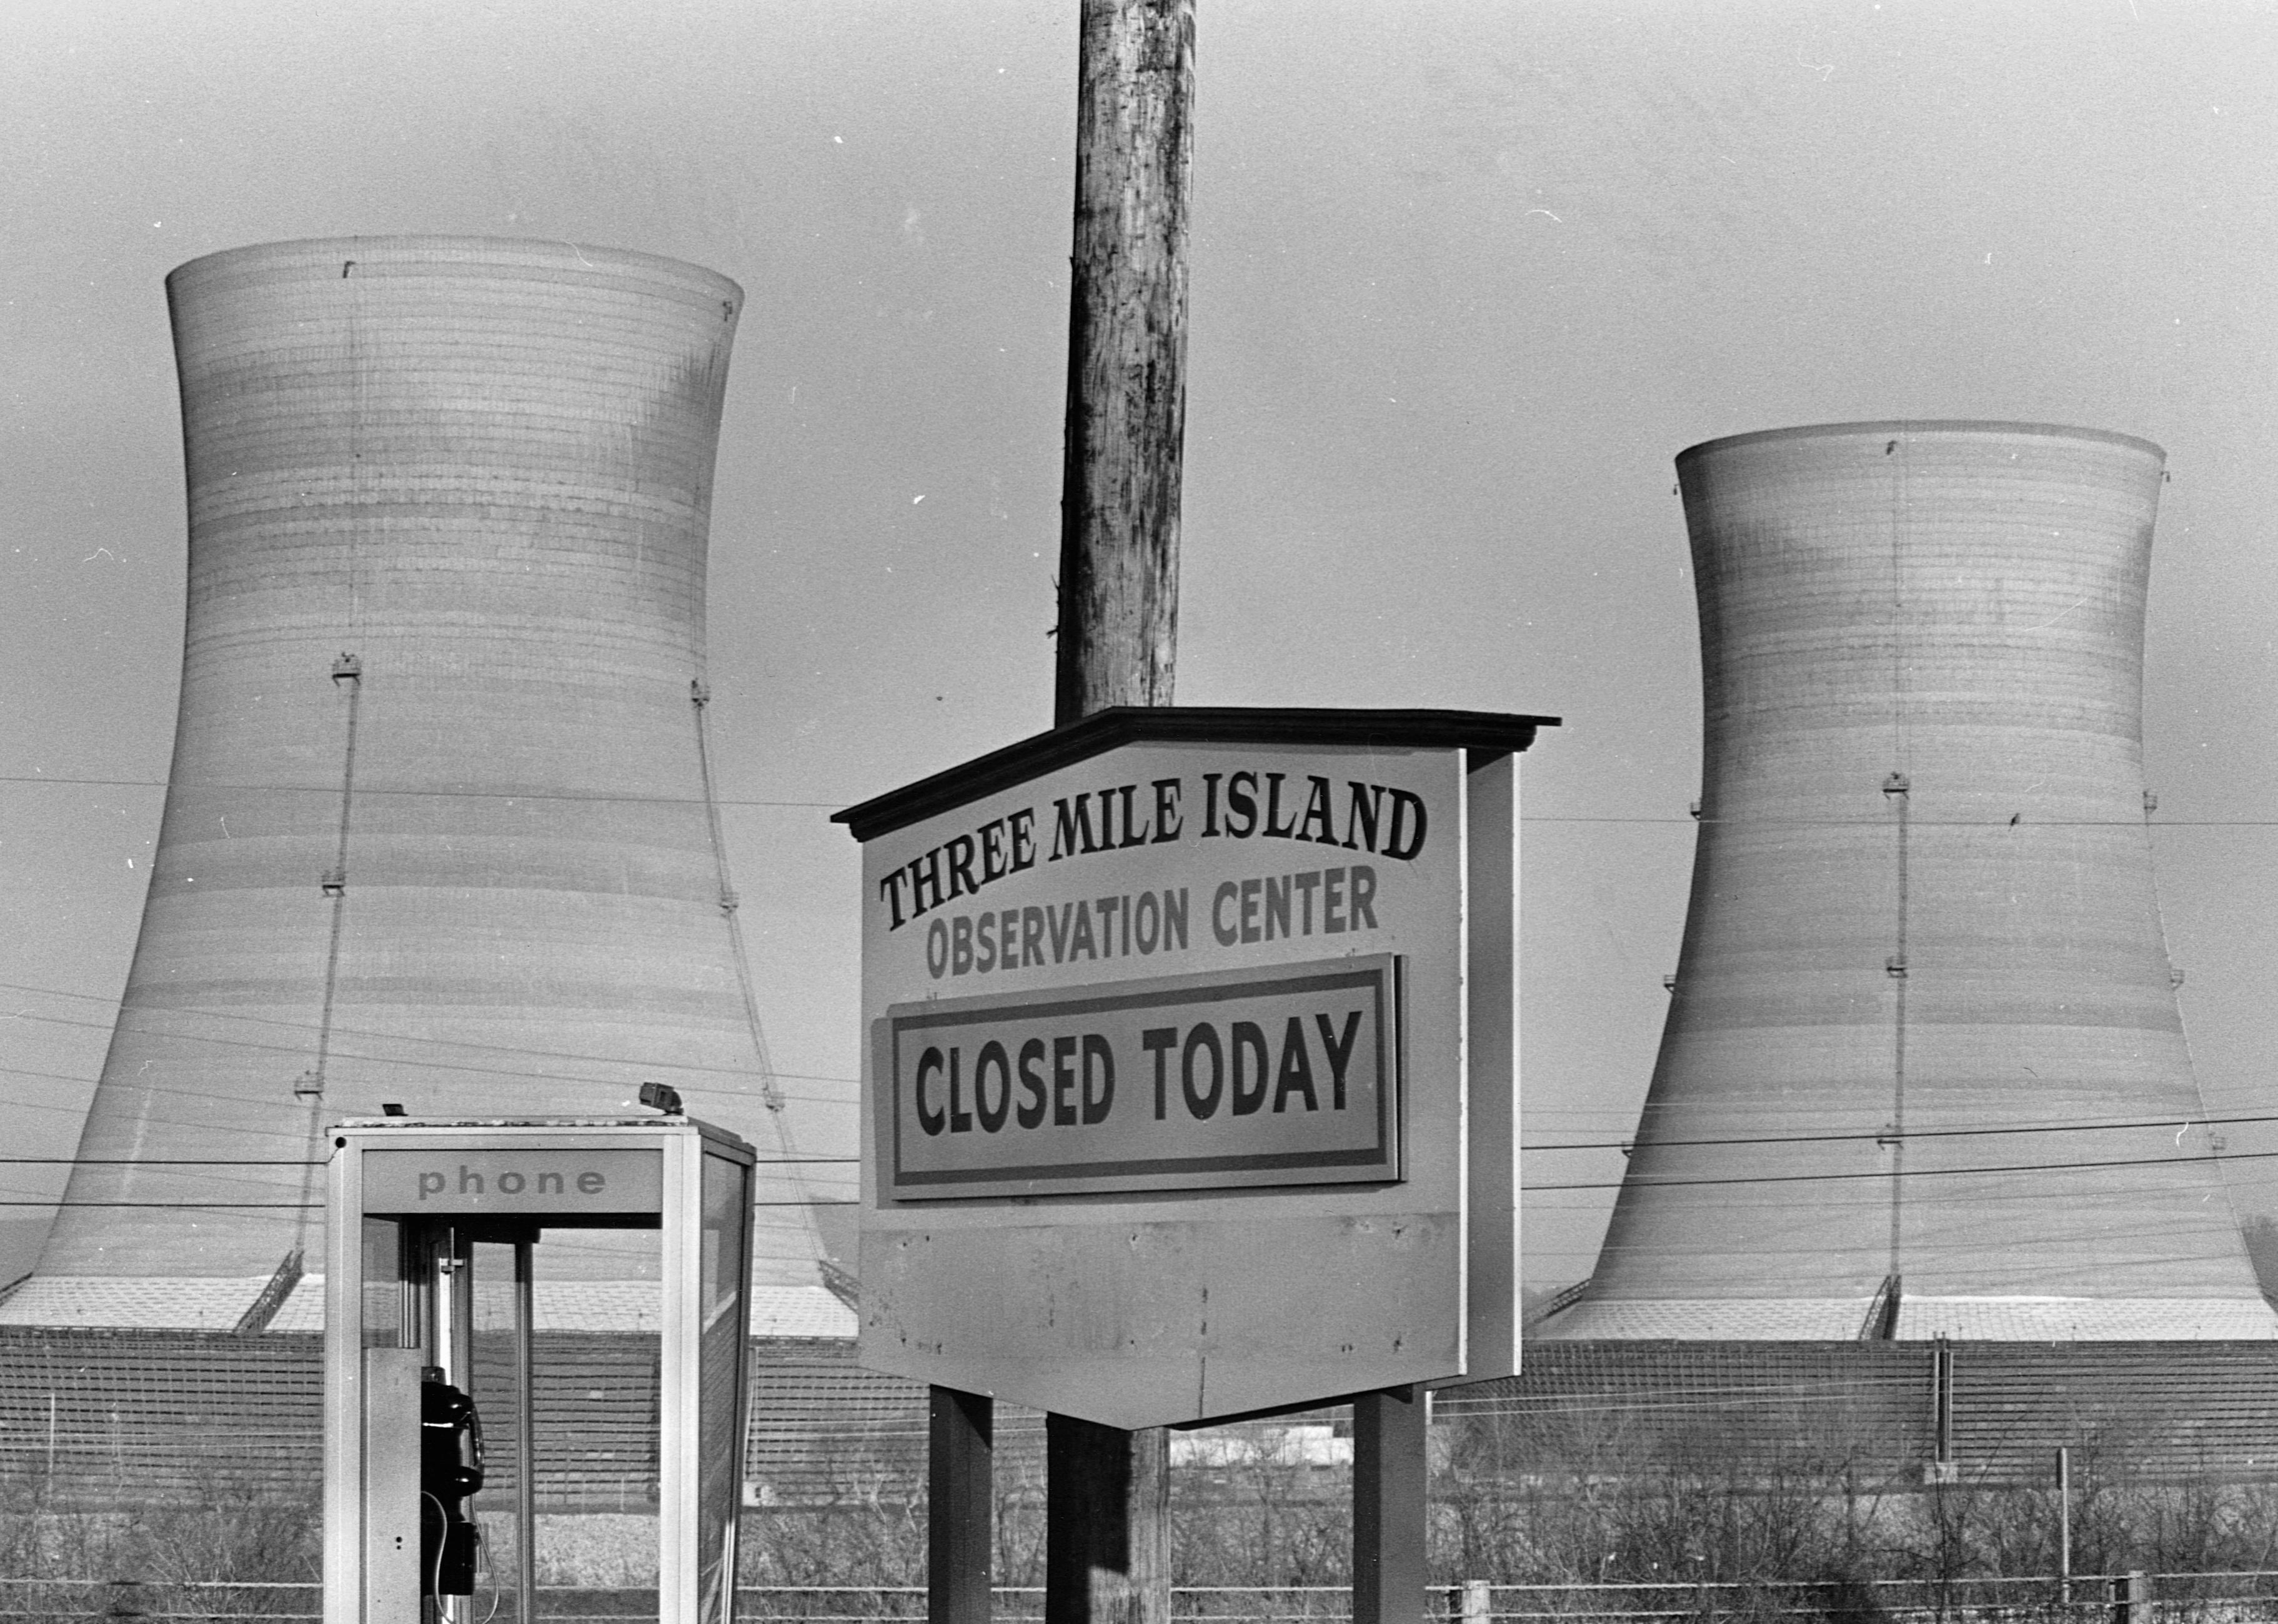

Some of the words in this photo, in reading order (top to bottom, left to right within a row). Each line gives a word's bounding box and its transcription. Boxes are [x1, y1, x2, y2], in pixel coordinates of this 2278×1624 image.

[880, 808, 1037, 932] THREE
[1048, 777, 1183, 862] MILE
[1201, 770, 1428, 861] ISLAND
[927, 888, 1189, 979] OBSERVATION
[1212, 864, 1379, 947] CENTER
[915, 1033, 1115, 1136] CLOSED
[1142, 1011, 1362, 1121] TODAY
[419, 1165, 607, 1201] phone
